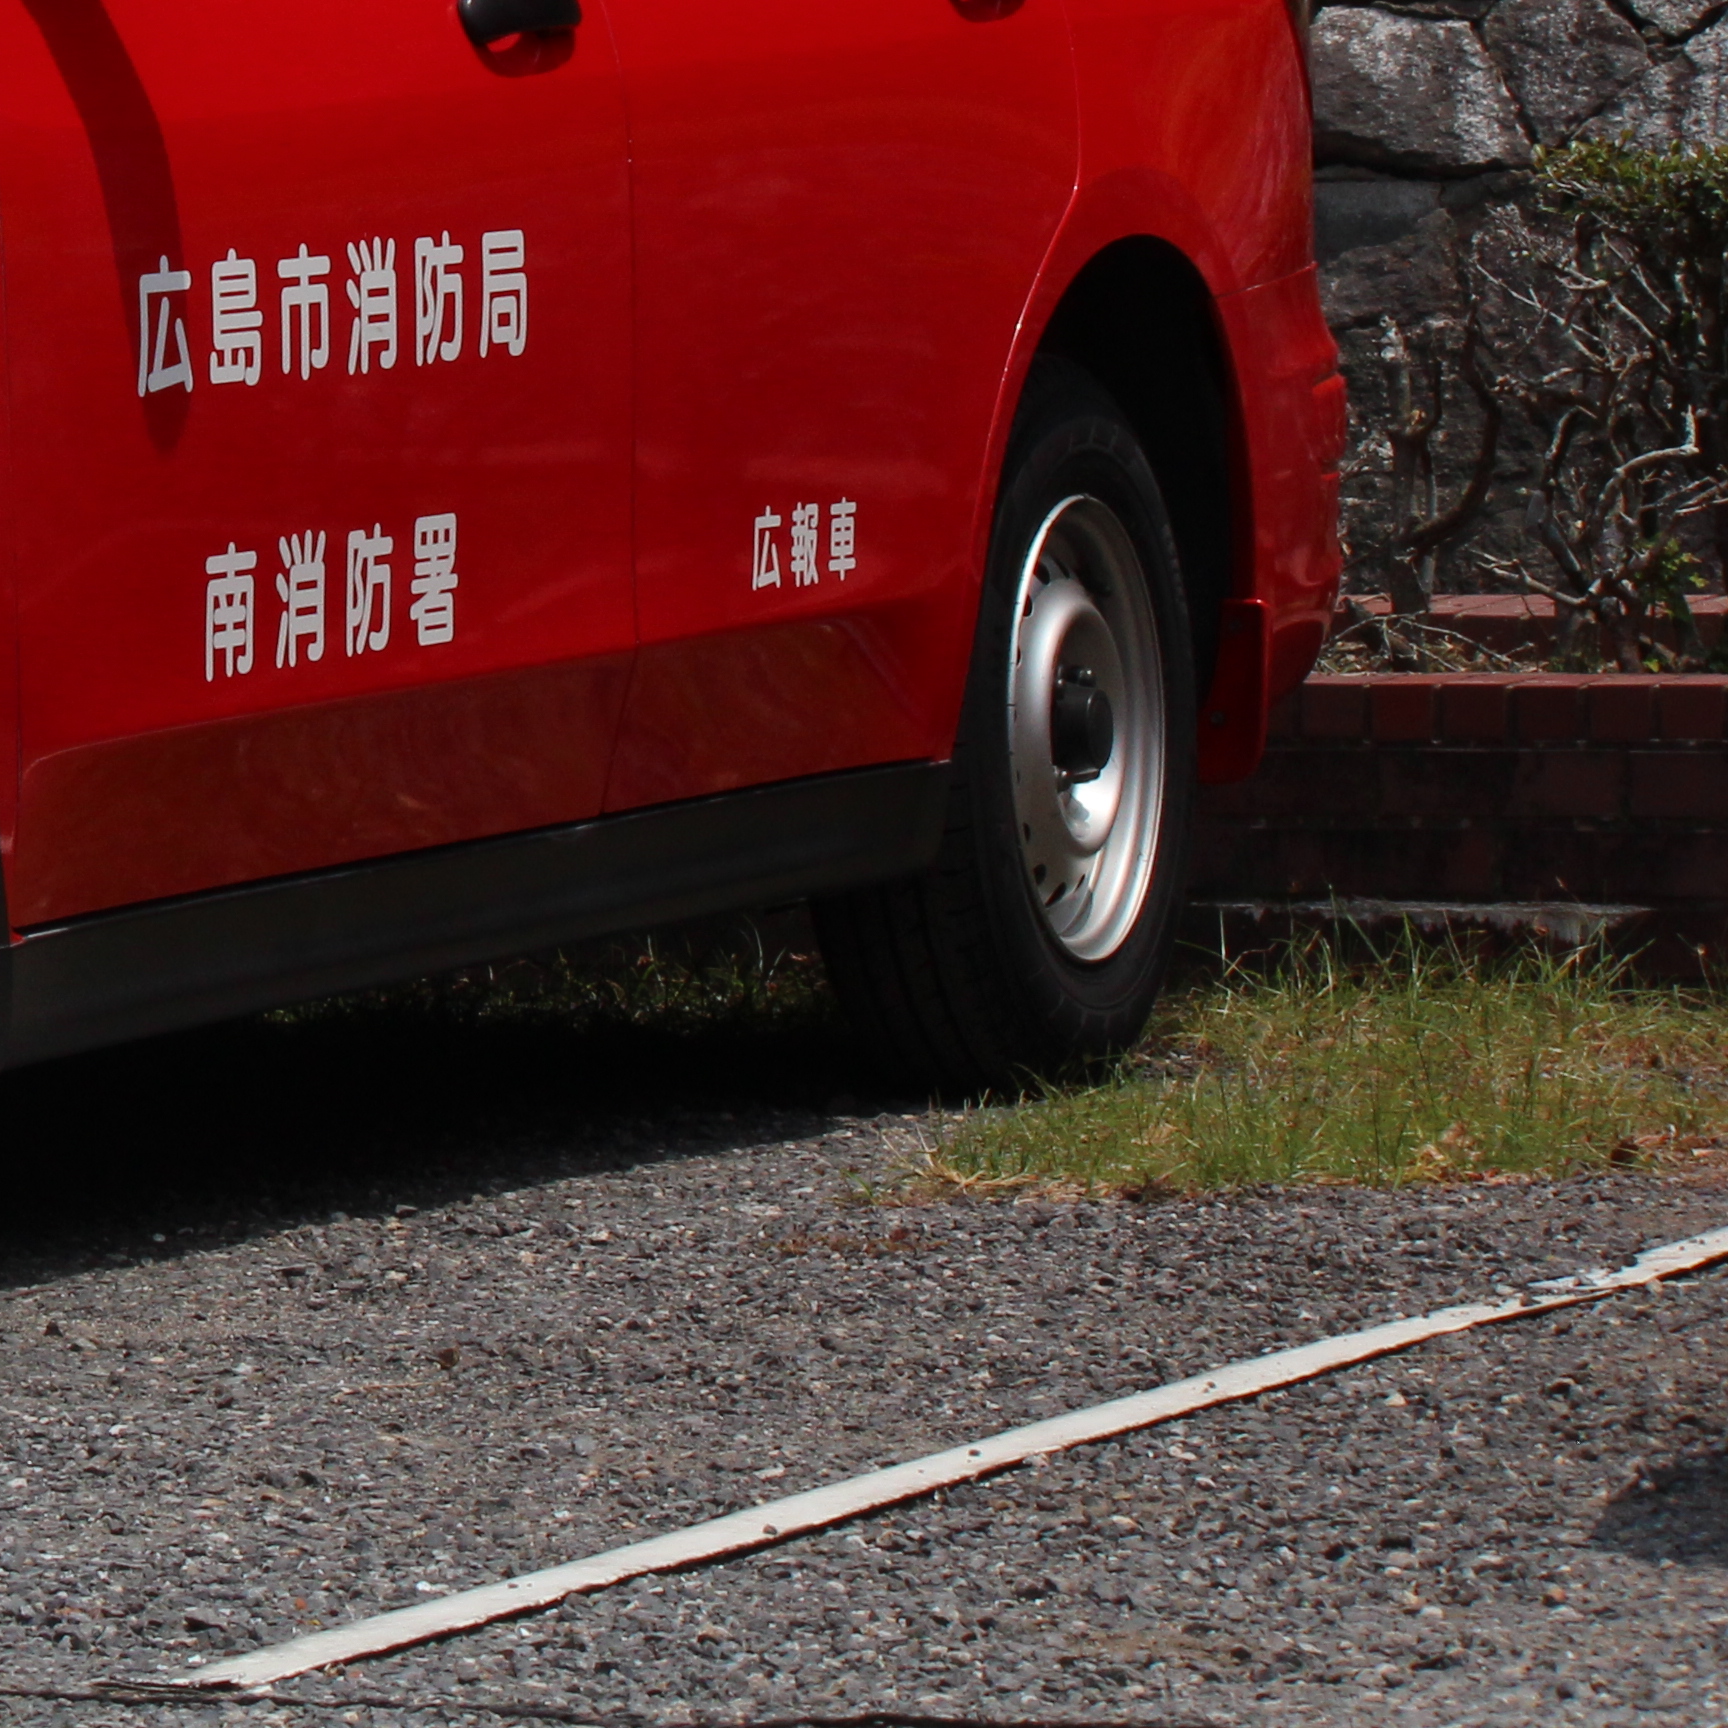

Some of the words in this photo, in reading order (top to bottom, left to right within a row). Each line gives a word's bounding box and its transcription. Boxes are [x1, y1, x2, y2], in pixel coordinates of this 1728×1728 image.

[137, 229, 528, 397] 広島市消防局
[204, 512, 458, 682] 南消防署
[752, 496, 856, 591] 広報車
